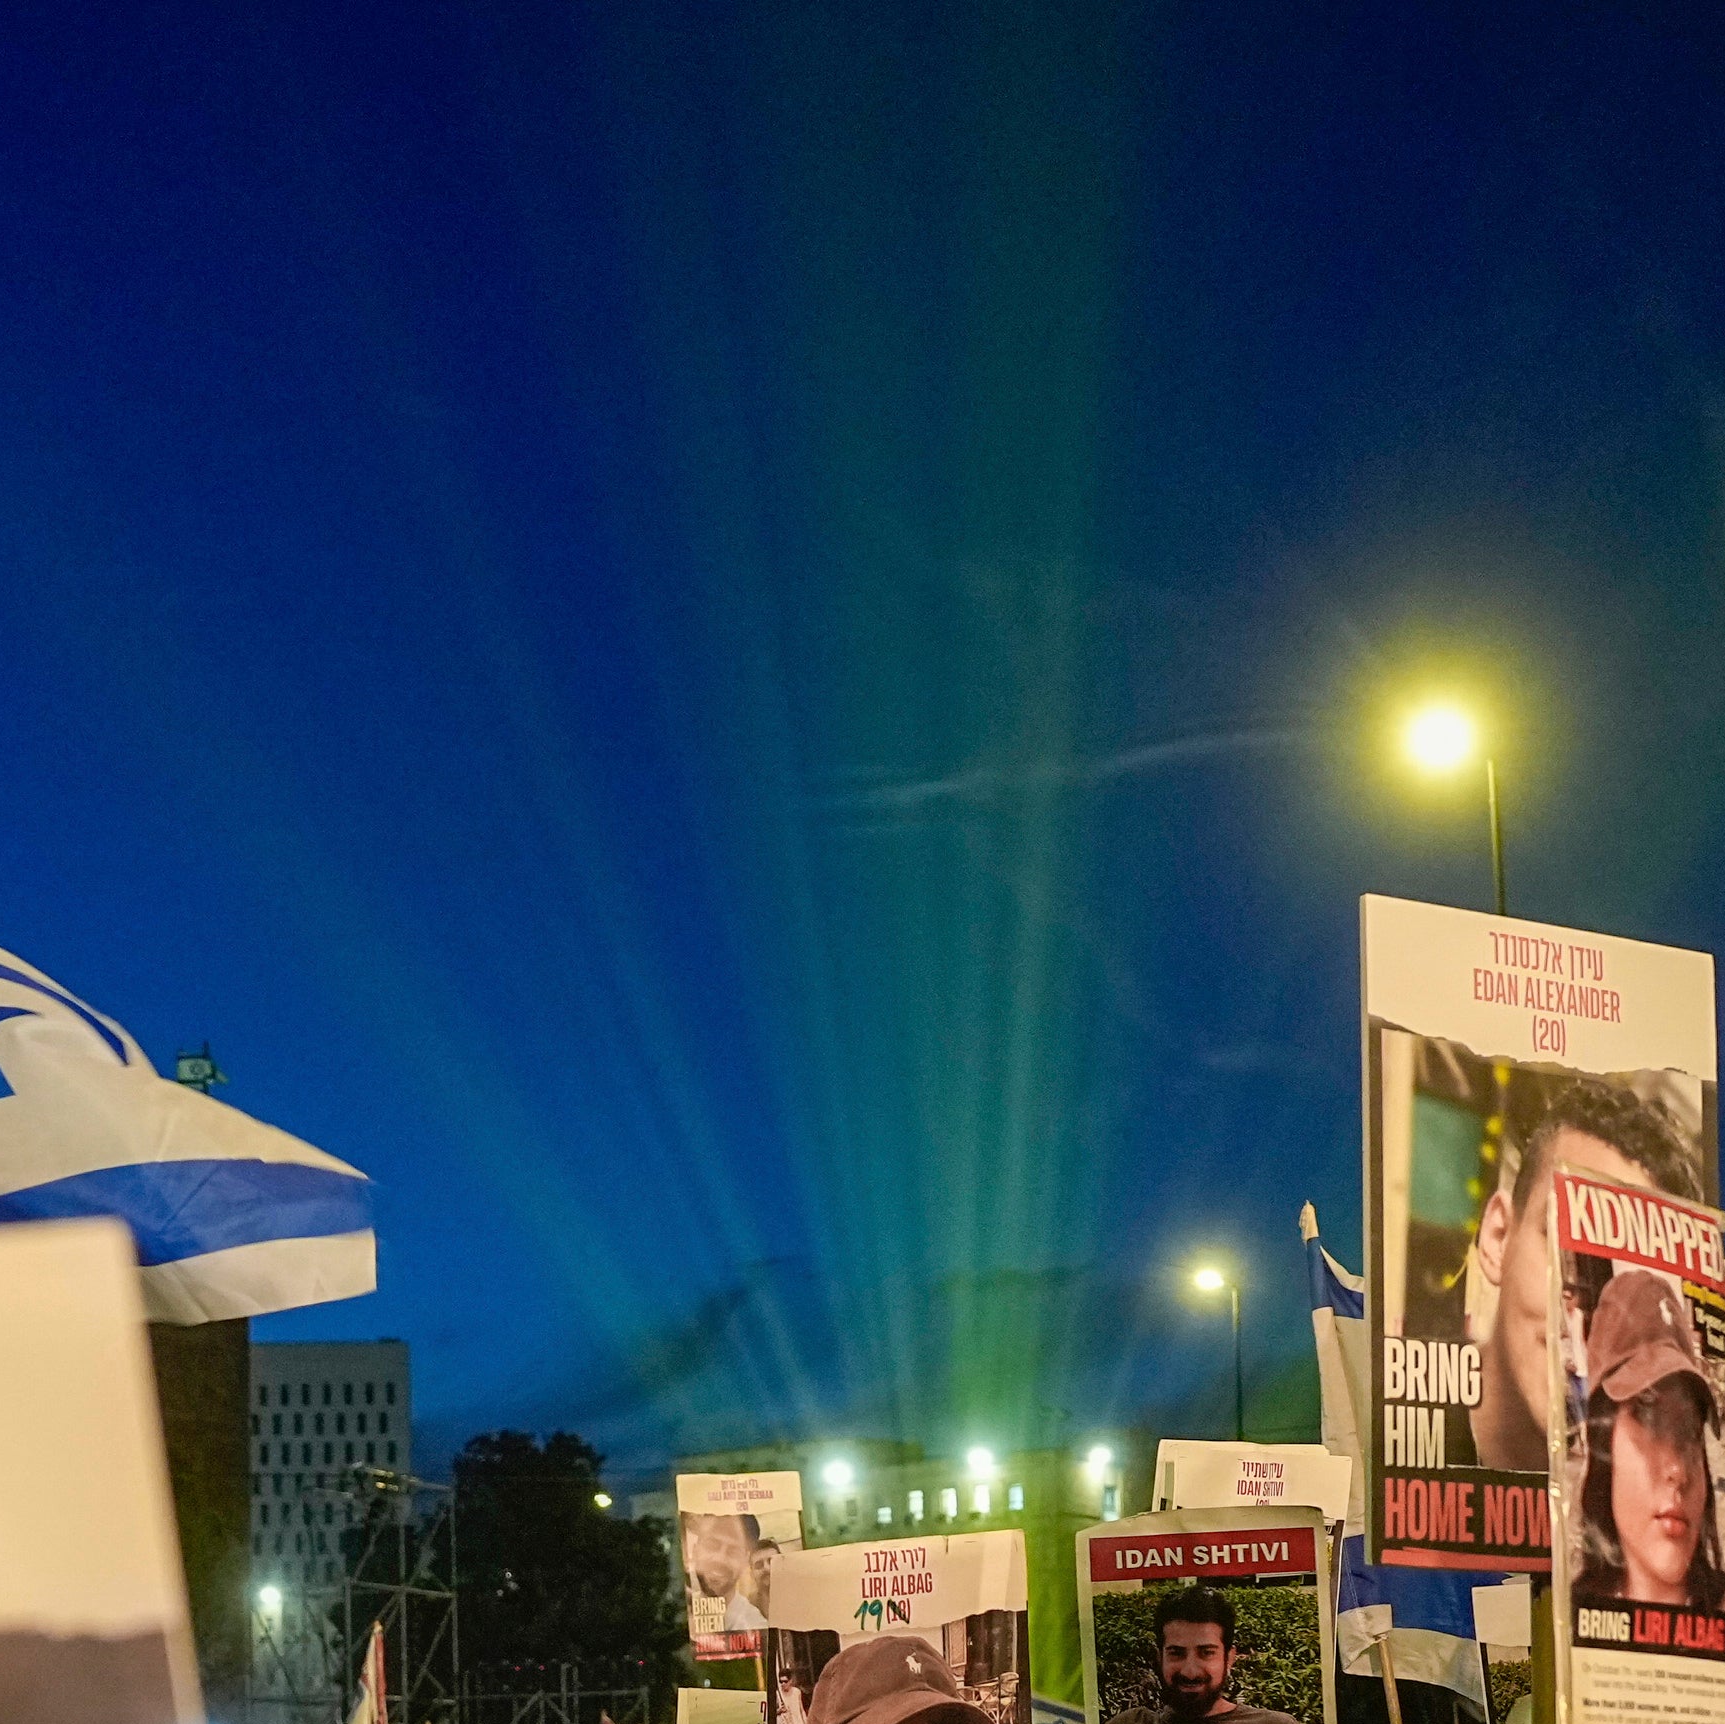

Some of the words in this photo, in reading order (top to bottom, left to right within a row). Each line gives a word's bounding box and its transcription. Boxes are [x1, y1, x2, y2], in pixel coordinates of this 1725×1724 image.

[1489, 931, 1564, 975] אלכסנדר
[1568, 945, 1604, 981] עידן
[1473, 968, 1518, 1006] EDAN
[1524, 976, 1621, 1023] ALEXANDER
[1532, 1014, 1567, 1057] (20)
[1564, 1179, 1725, 1283] KIDNAPPED
[1384, 1337, 1482, 1405] BRING
[1384, 1404, 1446, 1470] HIM
[1237, 1480, 1261, 1496] IDAN
[1384, 1477, 1475, 1543] HOME
[1484, 1484, 1552, 1548] NOW
[864, 1550, 899, 1573] אלבג
[901, 1547, 926, 1569] לירי
[1115, 1546, 1184, 1569] IDAN
[1192, 1541, 1290, 1566] SHTIVI
[861, 1576, 887, 1598] LIRI
[891, 1572, 933, 1596] ALBAG
[693, 1596, 726, 1616] BRING
[694, 1615, 725, 1633] THEM
[1578, 1607, 1632, 1643] BRING
[1632, 1608, 1671, 1645] LIRI
